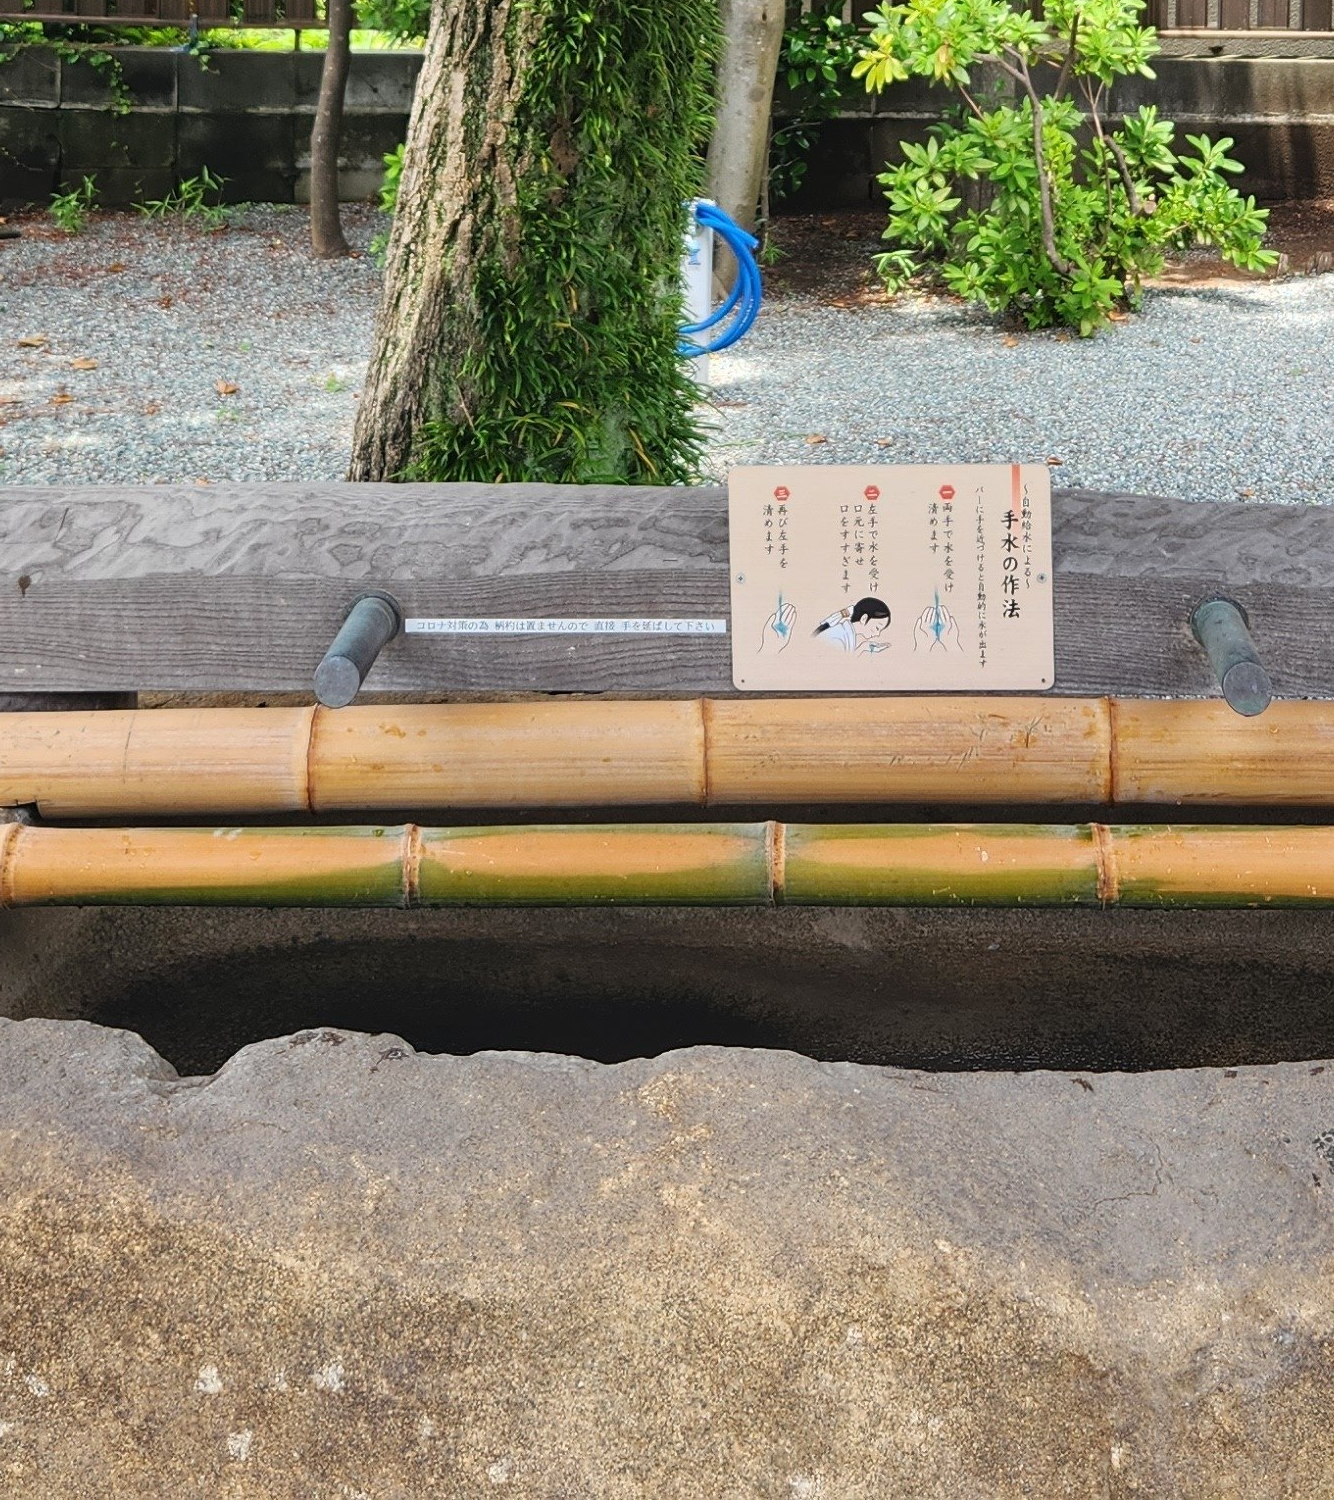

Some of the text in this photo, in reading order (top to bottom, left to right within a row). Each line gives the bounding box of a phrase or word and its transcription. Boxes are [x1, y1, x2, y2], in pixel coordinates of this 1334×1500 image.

[762, 504, 775, 555] 清めます
[777, 504, 789, 569] 再び左手を
[839, 504, 852, 594] 口をすすぎます
[853, 504, 865, 567] 口元に寄せ
[867, 503, 880, 593] 左手で水を受け
[928, 503, 940, 554] 清めます
[942, 502, 955, 593] 両手で水を受け
[1000, 509, 1021, 619] 手水の作法
[416, 620, 489, 632] コロナ対策の為
[593, 620, 616, 632] 直接
